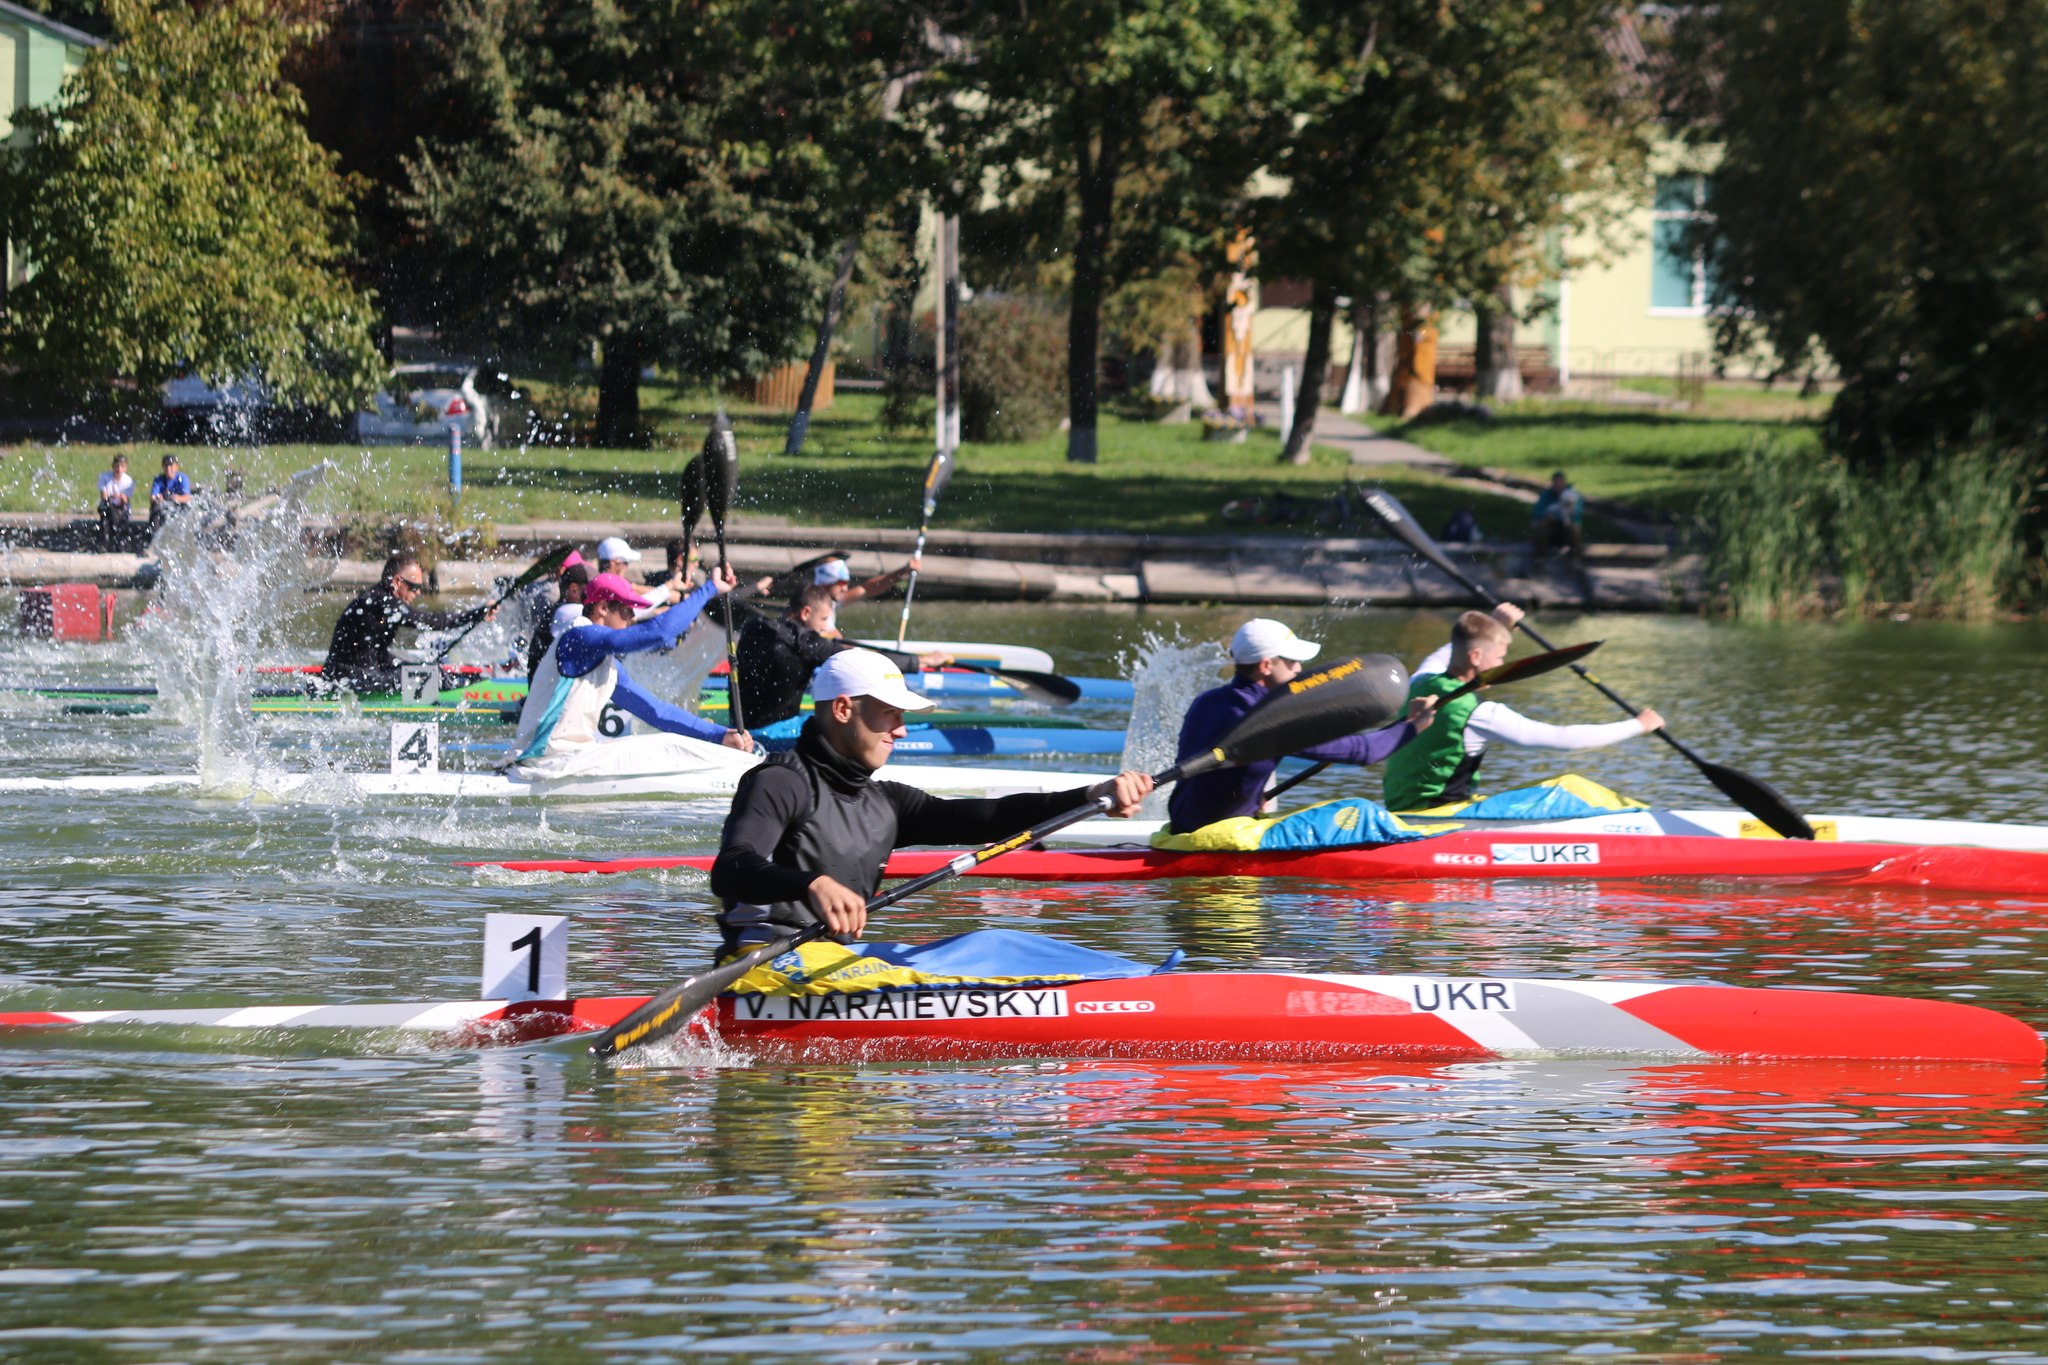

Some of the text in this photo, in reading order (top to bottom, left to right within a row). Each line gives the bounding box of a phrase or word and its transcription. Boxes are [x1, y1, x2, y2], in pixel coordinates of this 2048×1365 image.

[408, 672, 432, 699] 7
[465, 691, 524, 701] NELO
[598, 703, 624, 737] 6
[398, 728, 433, 767] 4
[1530, 845, 1591, 863] UKR
[511, 926, 542, 995] 1
[746, 990, 1060, 1018] V. NARAIEVSKYI
[1080, 1002, 1151, 1012] NELO
[1414, 982, 1511, 1011] UKR
